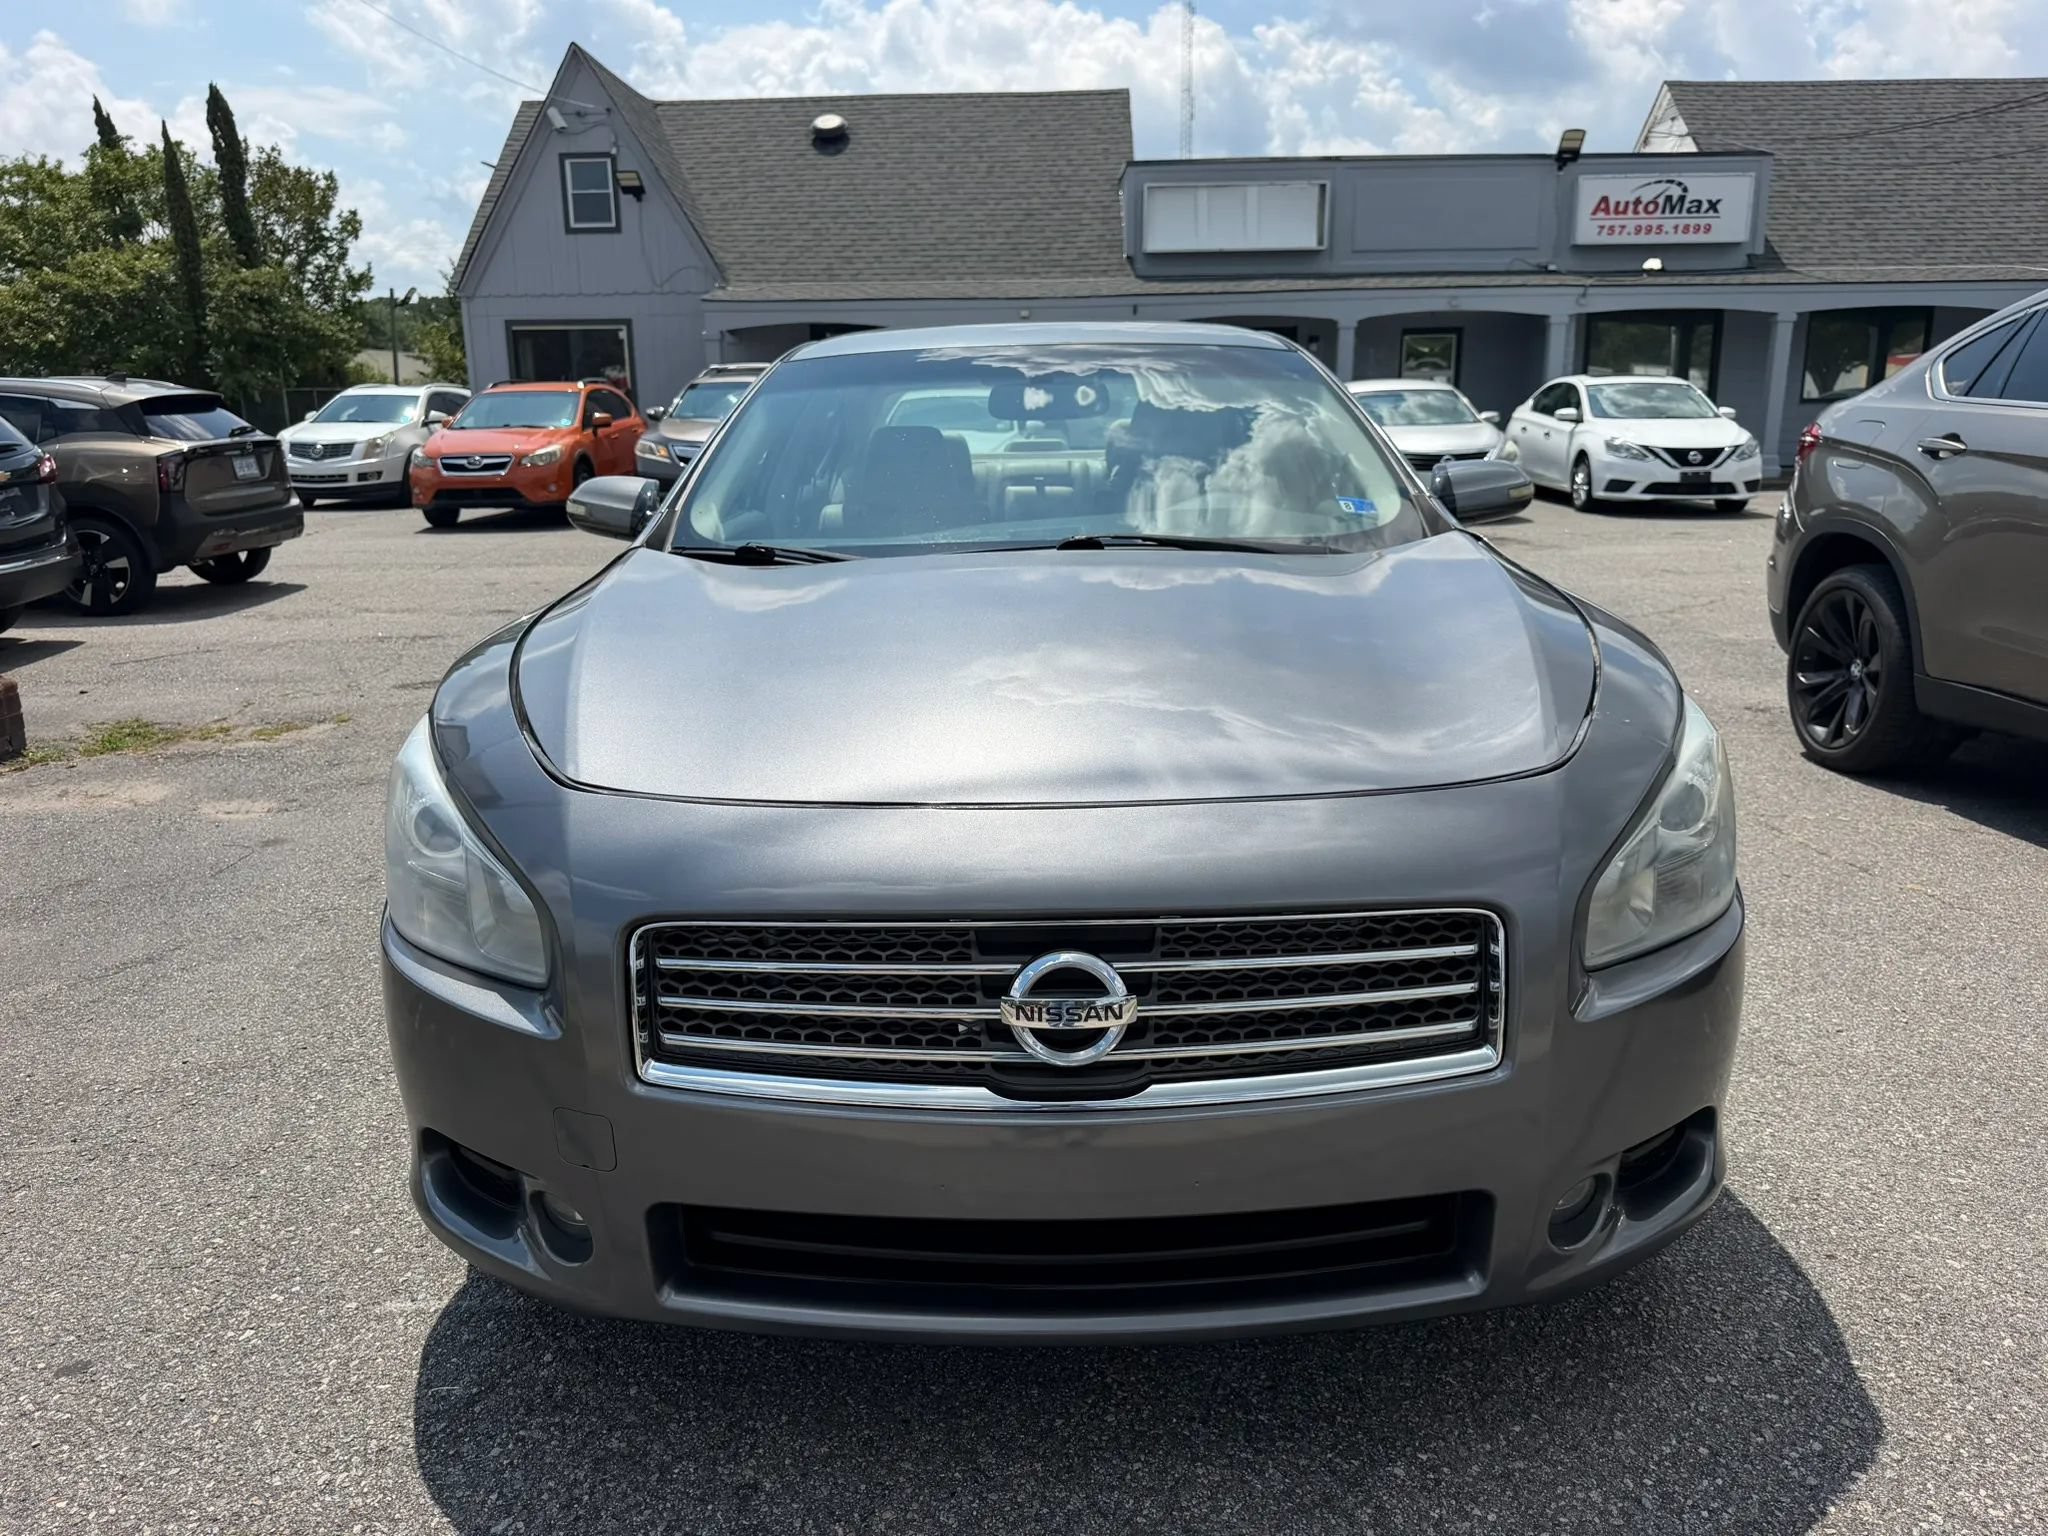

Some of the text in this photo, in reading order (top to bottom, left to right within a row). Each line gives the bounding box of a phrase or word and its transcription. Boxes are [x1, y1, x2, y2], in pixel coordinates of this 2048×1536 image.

[1590, 194, 1723, 216] AutoMax
[1596, 223, 1713, 236] 757.995.1899
[1015, 1003, 1124, 1022] NISSAN
